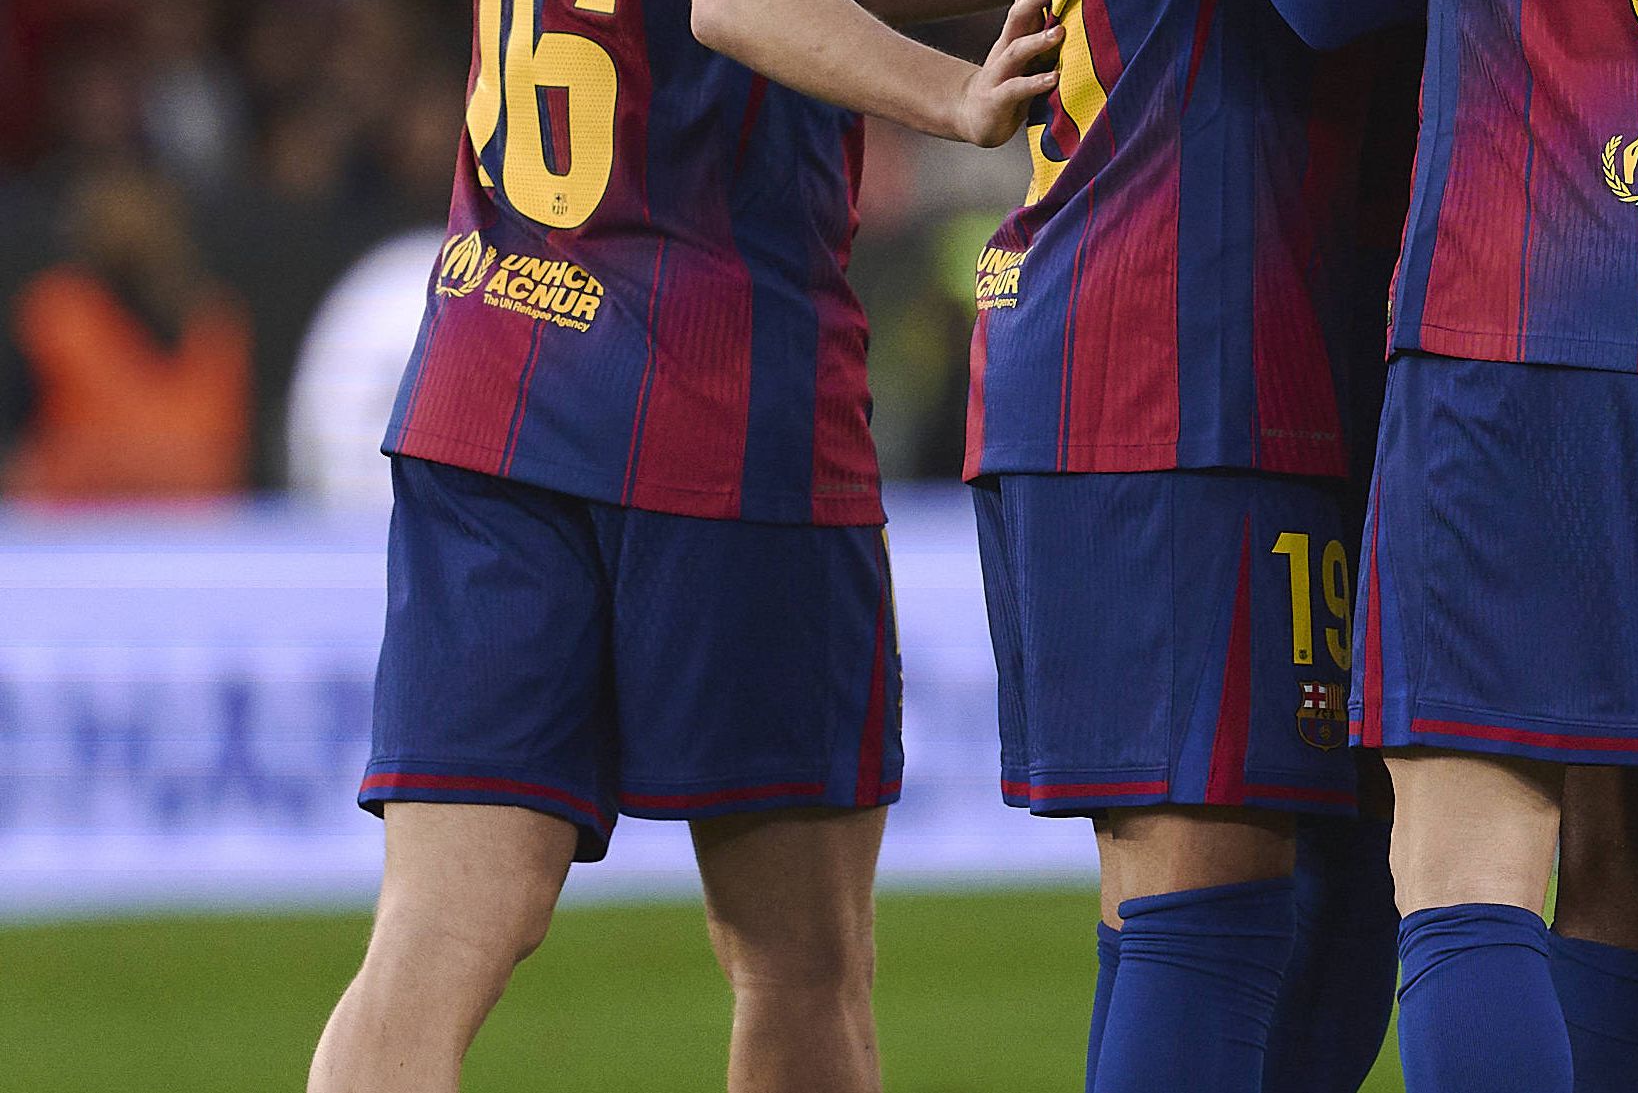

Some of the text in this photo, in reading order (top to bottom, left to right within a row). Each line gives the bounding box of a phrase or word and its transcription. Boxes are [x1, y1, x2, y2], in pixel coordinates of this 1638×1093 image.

[483, 293, 591, 333] The UN Refugee Agency
[485, 269, 601, 321] ACNUR
[1271, 532, 1351, 671] 19
